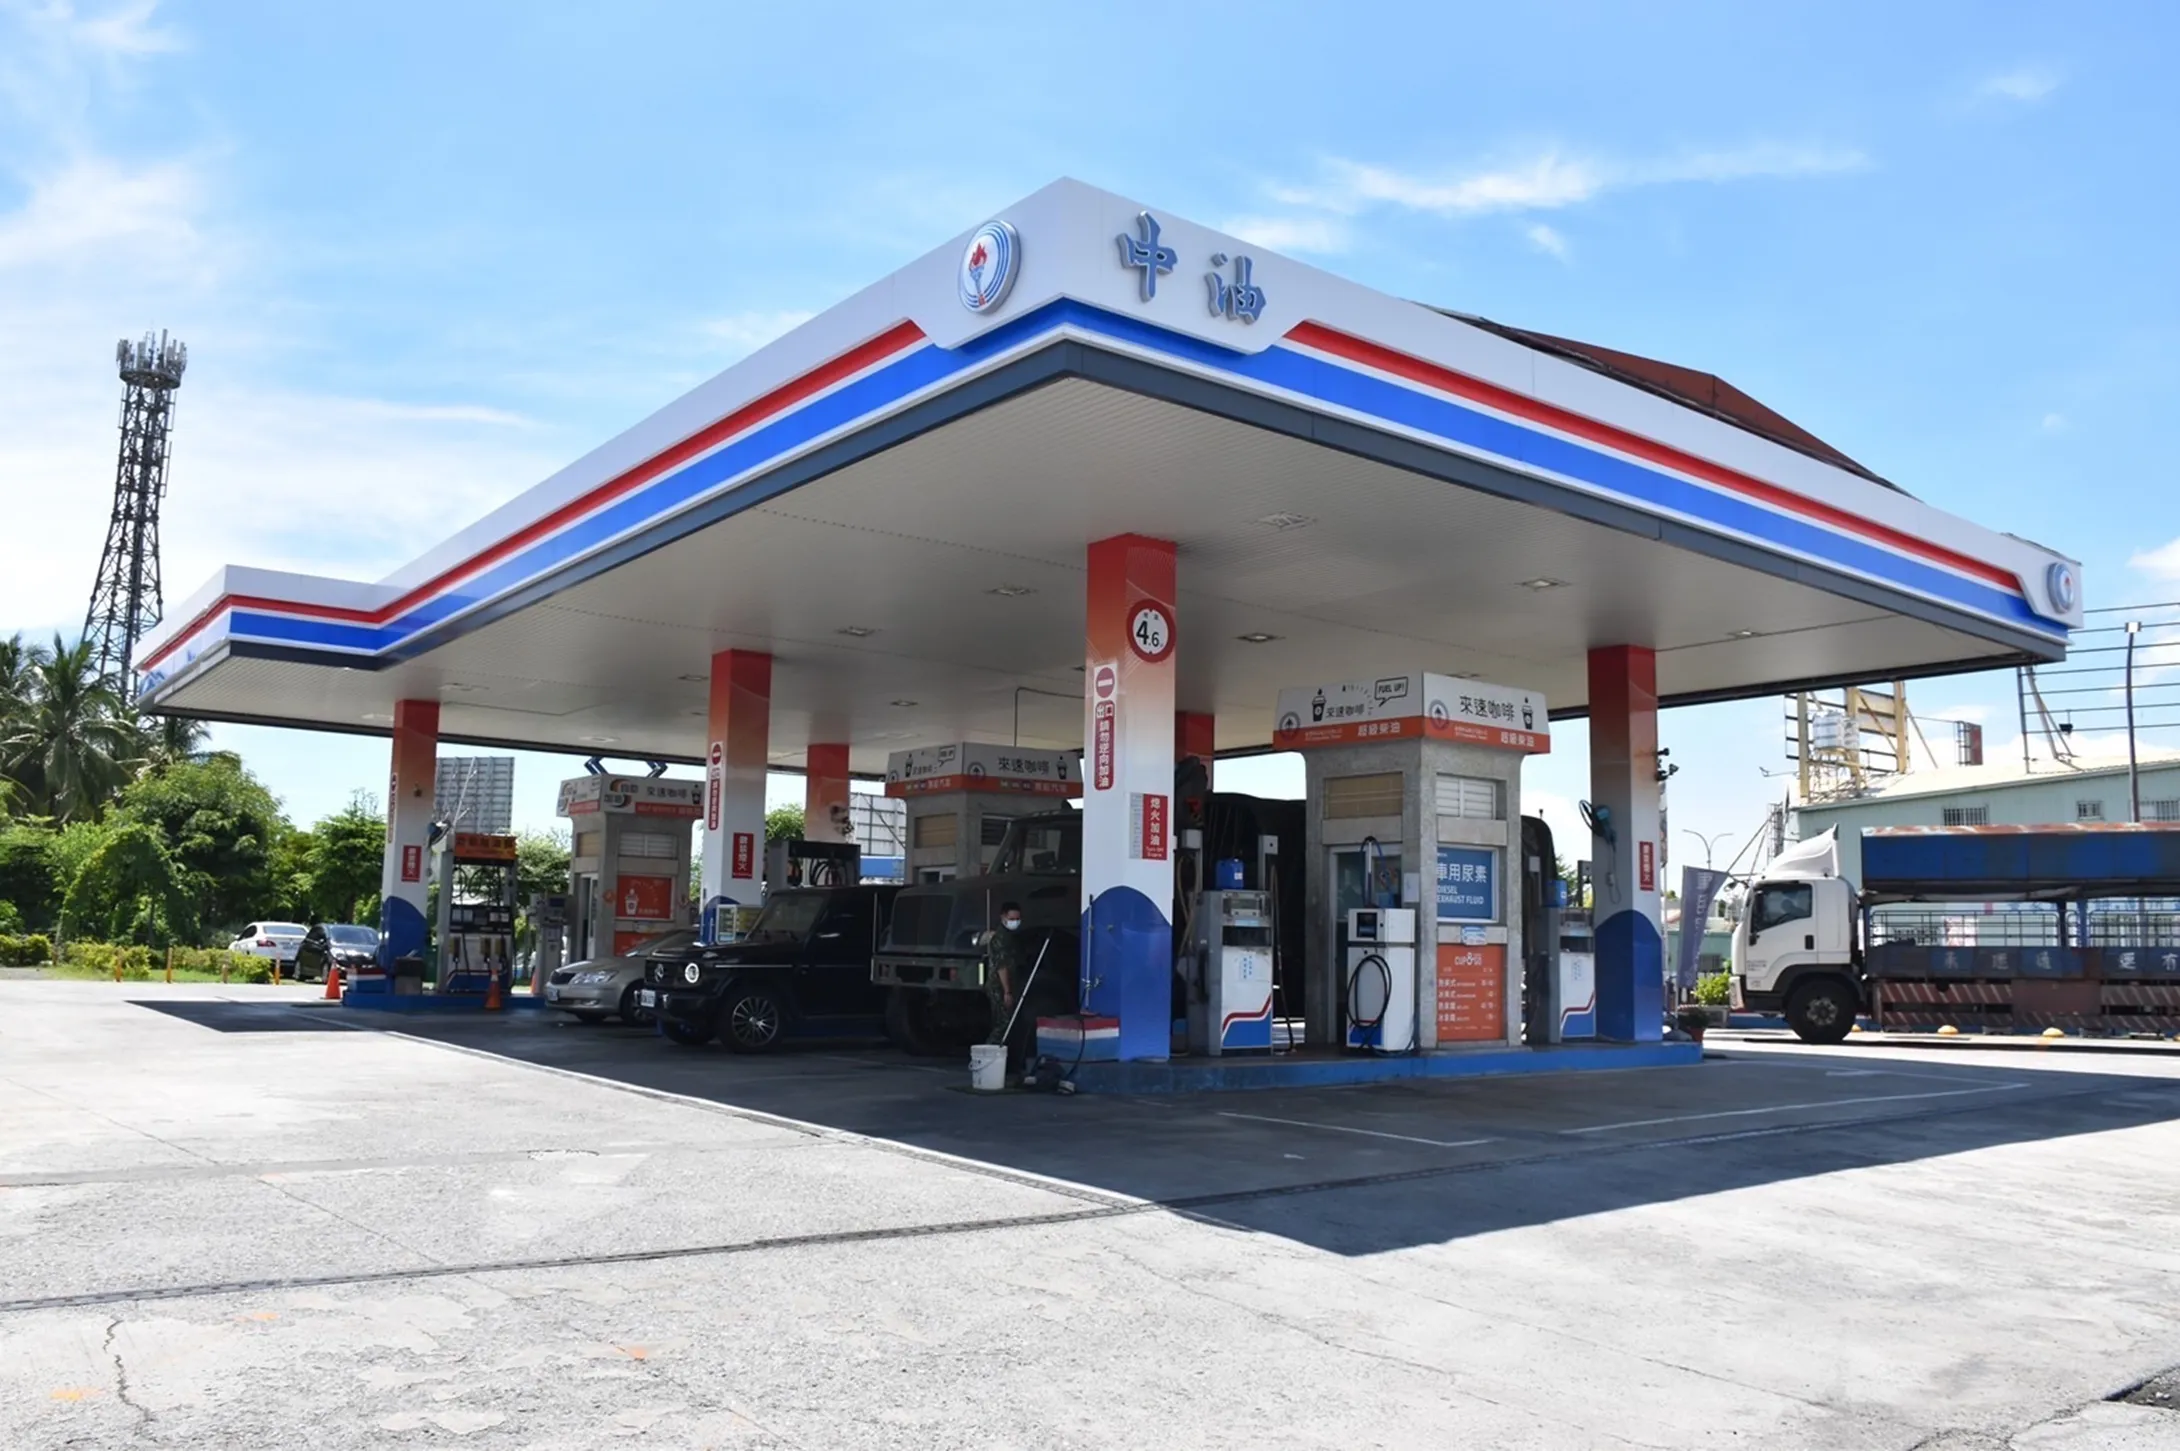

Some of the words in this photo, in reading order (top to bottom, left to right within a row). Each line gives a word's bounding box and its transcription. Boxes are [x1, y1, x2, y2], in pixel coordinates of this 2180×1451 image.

[1116, 211, 1267, 325] 中油
[1460, 696, 1515, 722] 來速咖啡
[998, 757, 1049, 775] 來速咖啡
[1437, 862, 1487, 883] 車用尿素
[1466, 895, 1485, 905] FLUID
